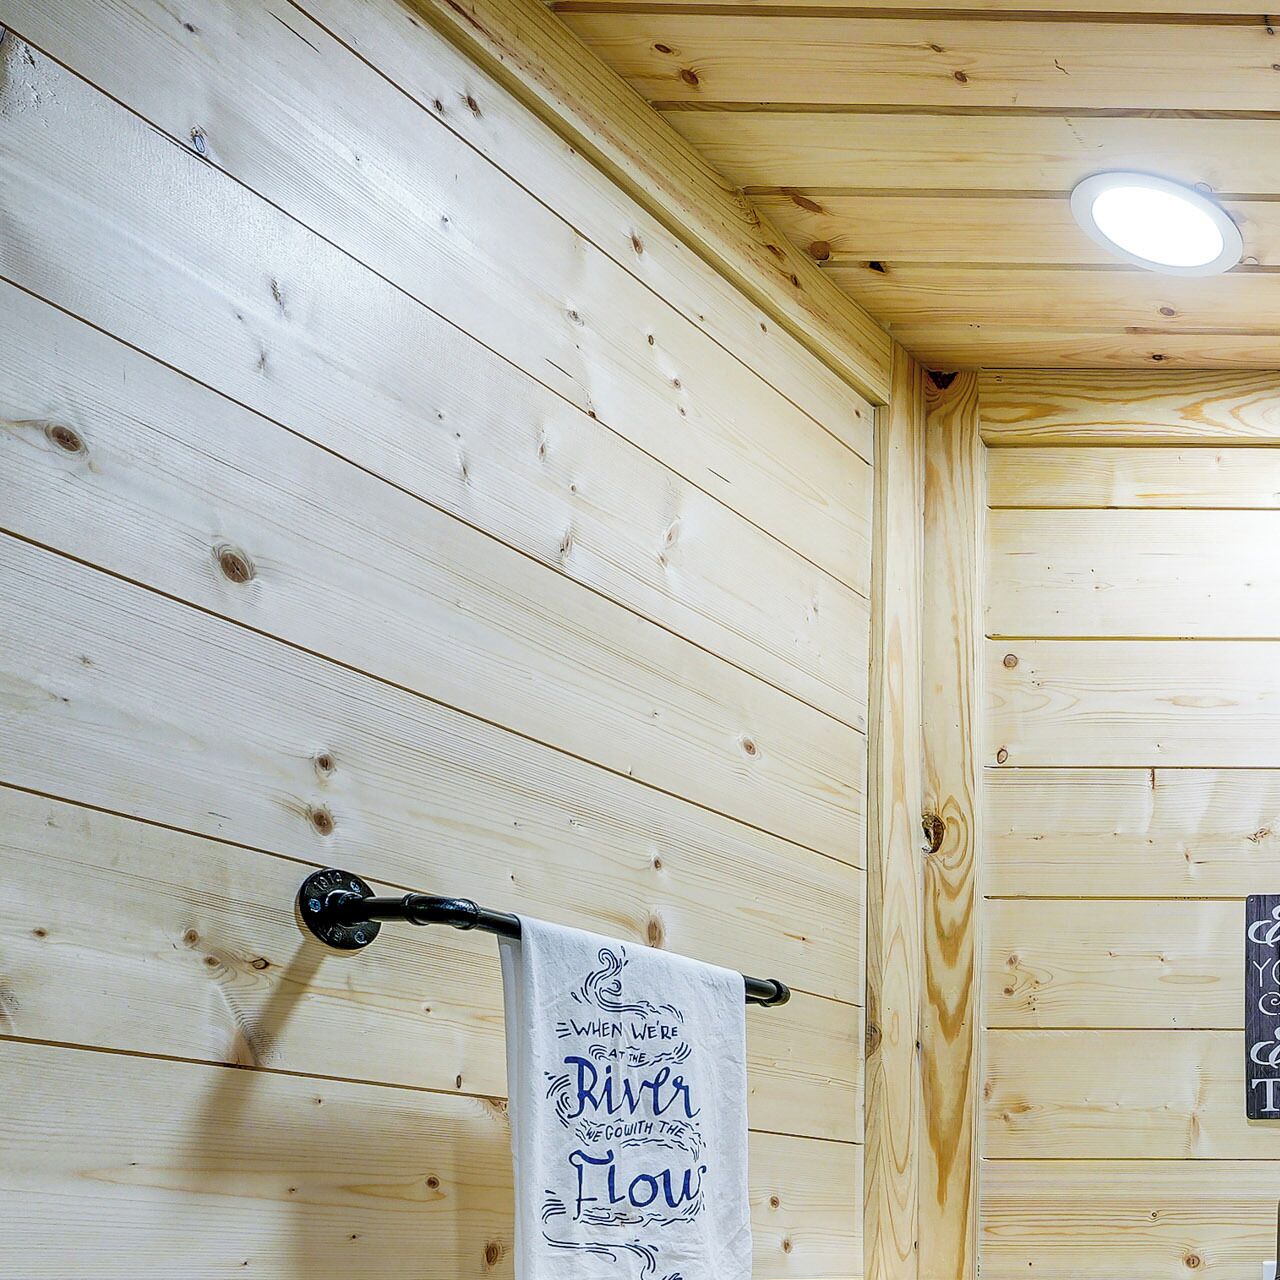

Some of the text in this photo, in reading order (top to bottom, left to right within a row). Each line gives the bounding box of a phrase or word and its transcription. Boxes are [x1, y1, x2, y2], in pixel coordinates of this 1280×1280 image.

[569, 1018, 679, 1041] WHEN WE'RE
[608, 1048, 647, 1063] AT THE
[563, 1055, 701, 1119] River
[586, 1127, 602, 1143] WE
[659, 1119, 686, 1139] THE
[568, 1149, 707, 1221] Flow
